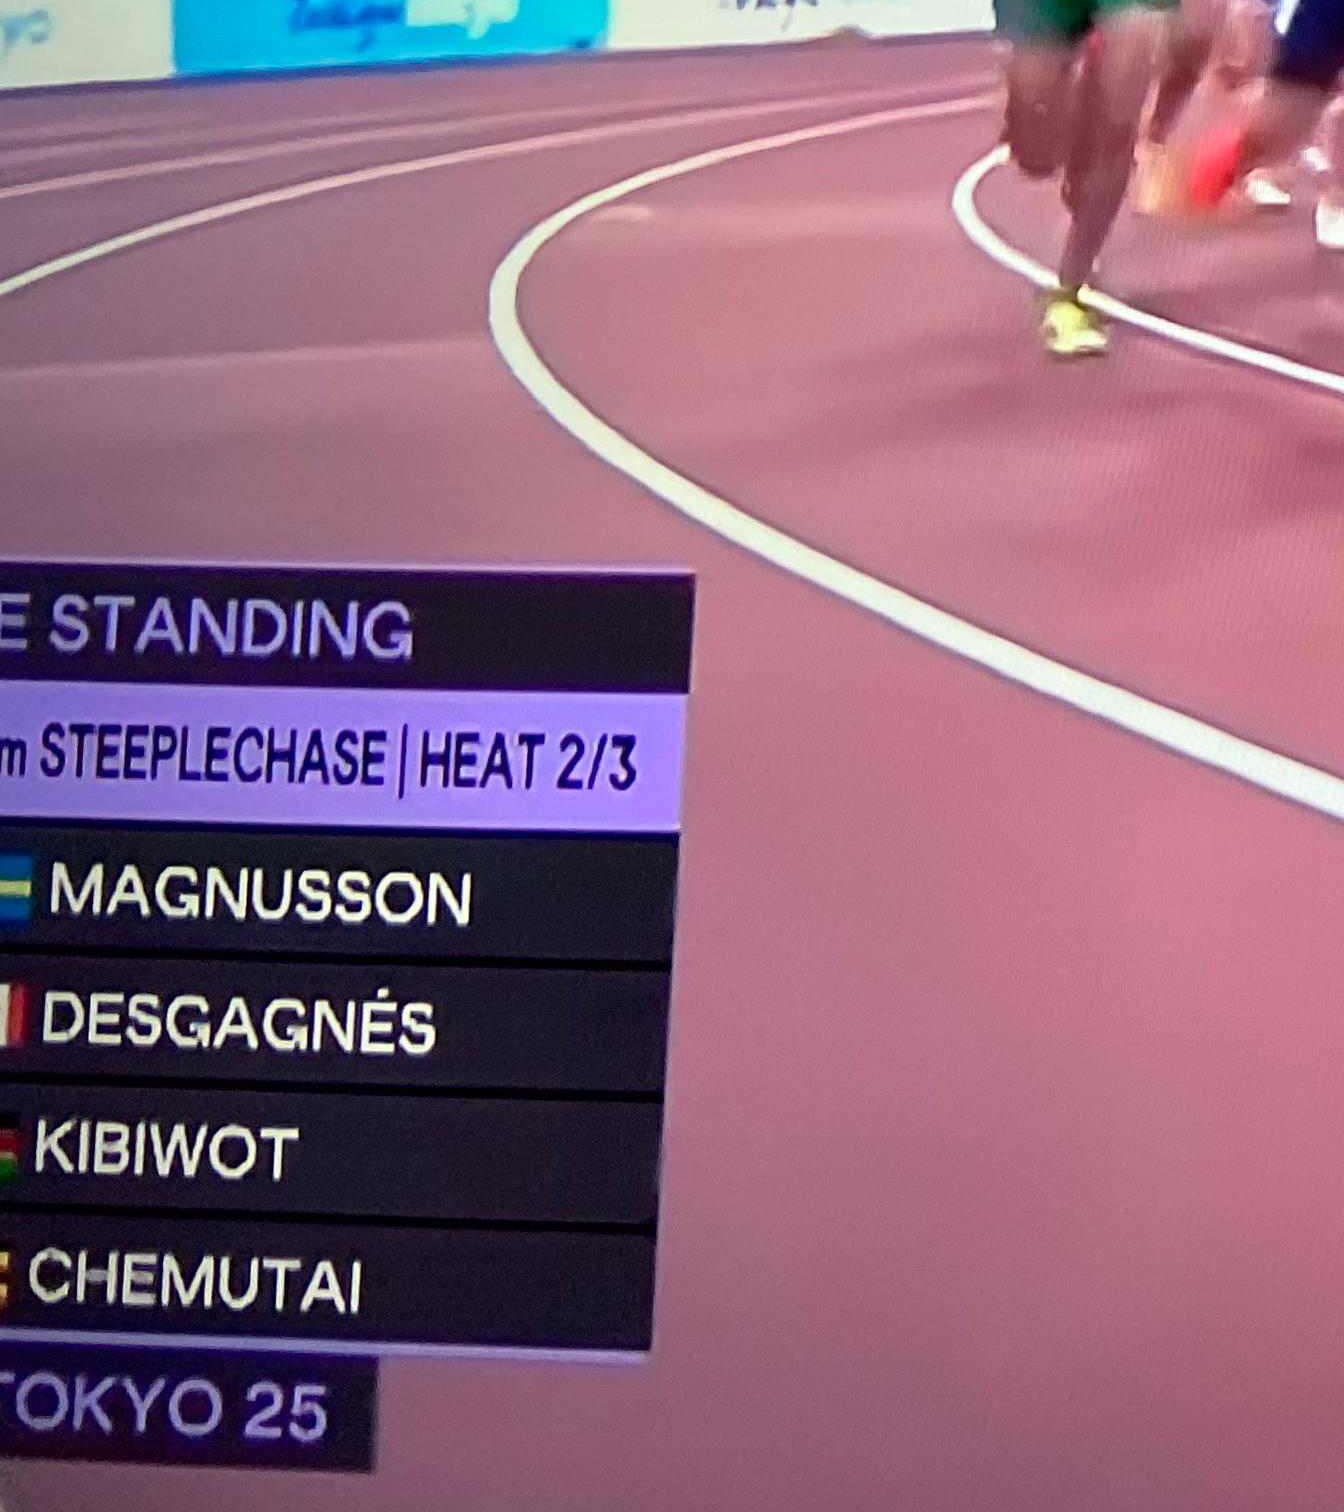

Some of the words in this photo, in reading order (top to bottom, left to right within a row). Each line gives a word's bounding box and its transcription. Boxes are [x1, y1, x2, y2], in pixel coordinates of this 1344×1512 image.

[50, 594, 413, 660] STANDING
[40, 722, 387, 786] STEEPLECHASE
[420, 730, 546, 790] HEAT
[556, 733, 637, 791] 2/3
[50, 862, 472, 926] MAGNUSSON
[42, 987, 436, 1055] DESGAGNÉS
[35, 1118, 300, 1181] KIBIWOT
[29, 1247, 362, 1314] CHEMUTAI
[244, 1381, 328, 1442] 25
